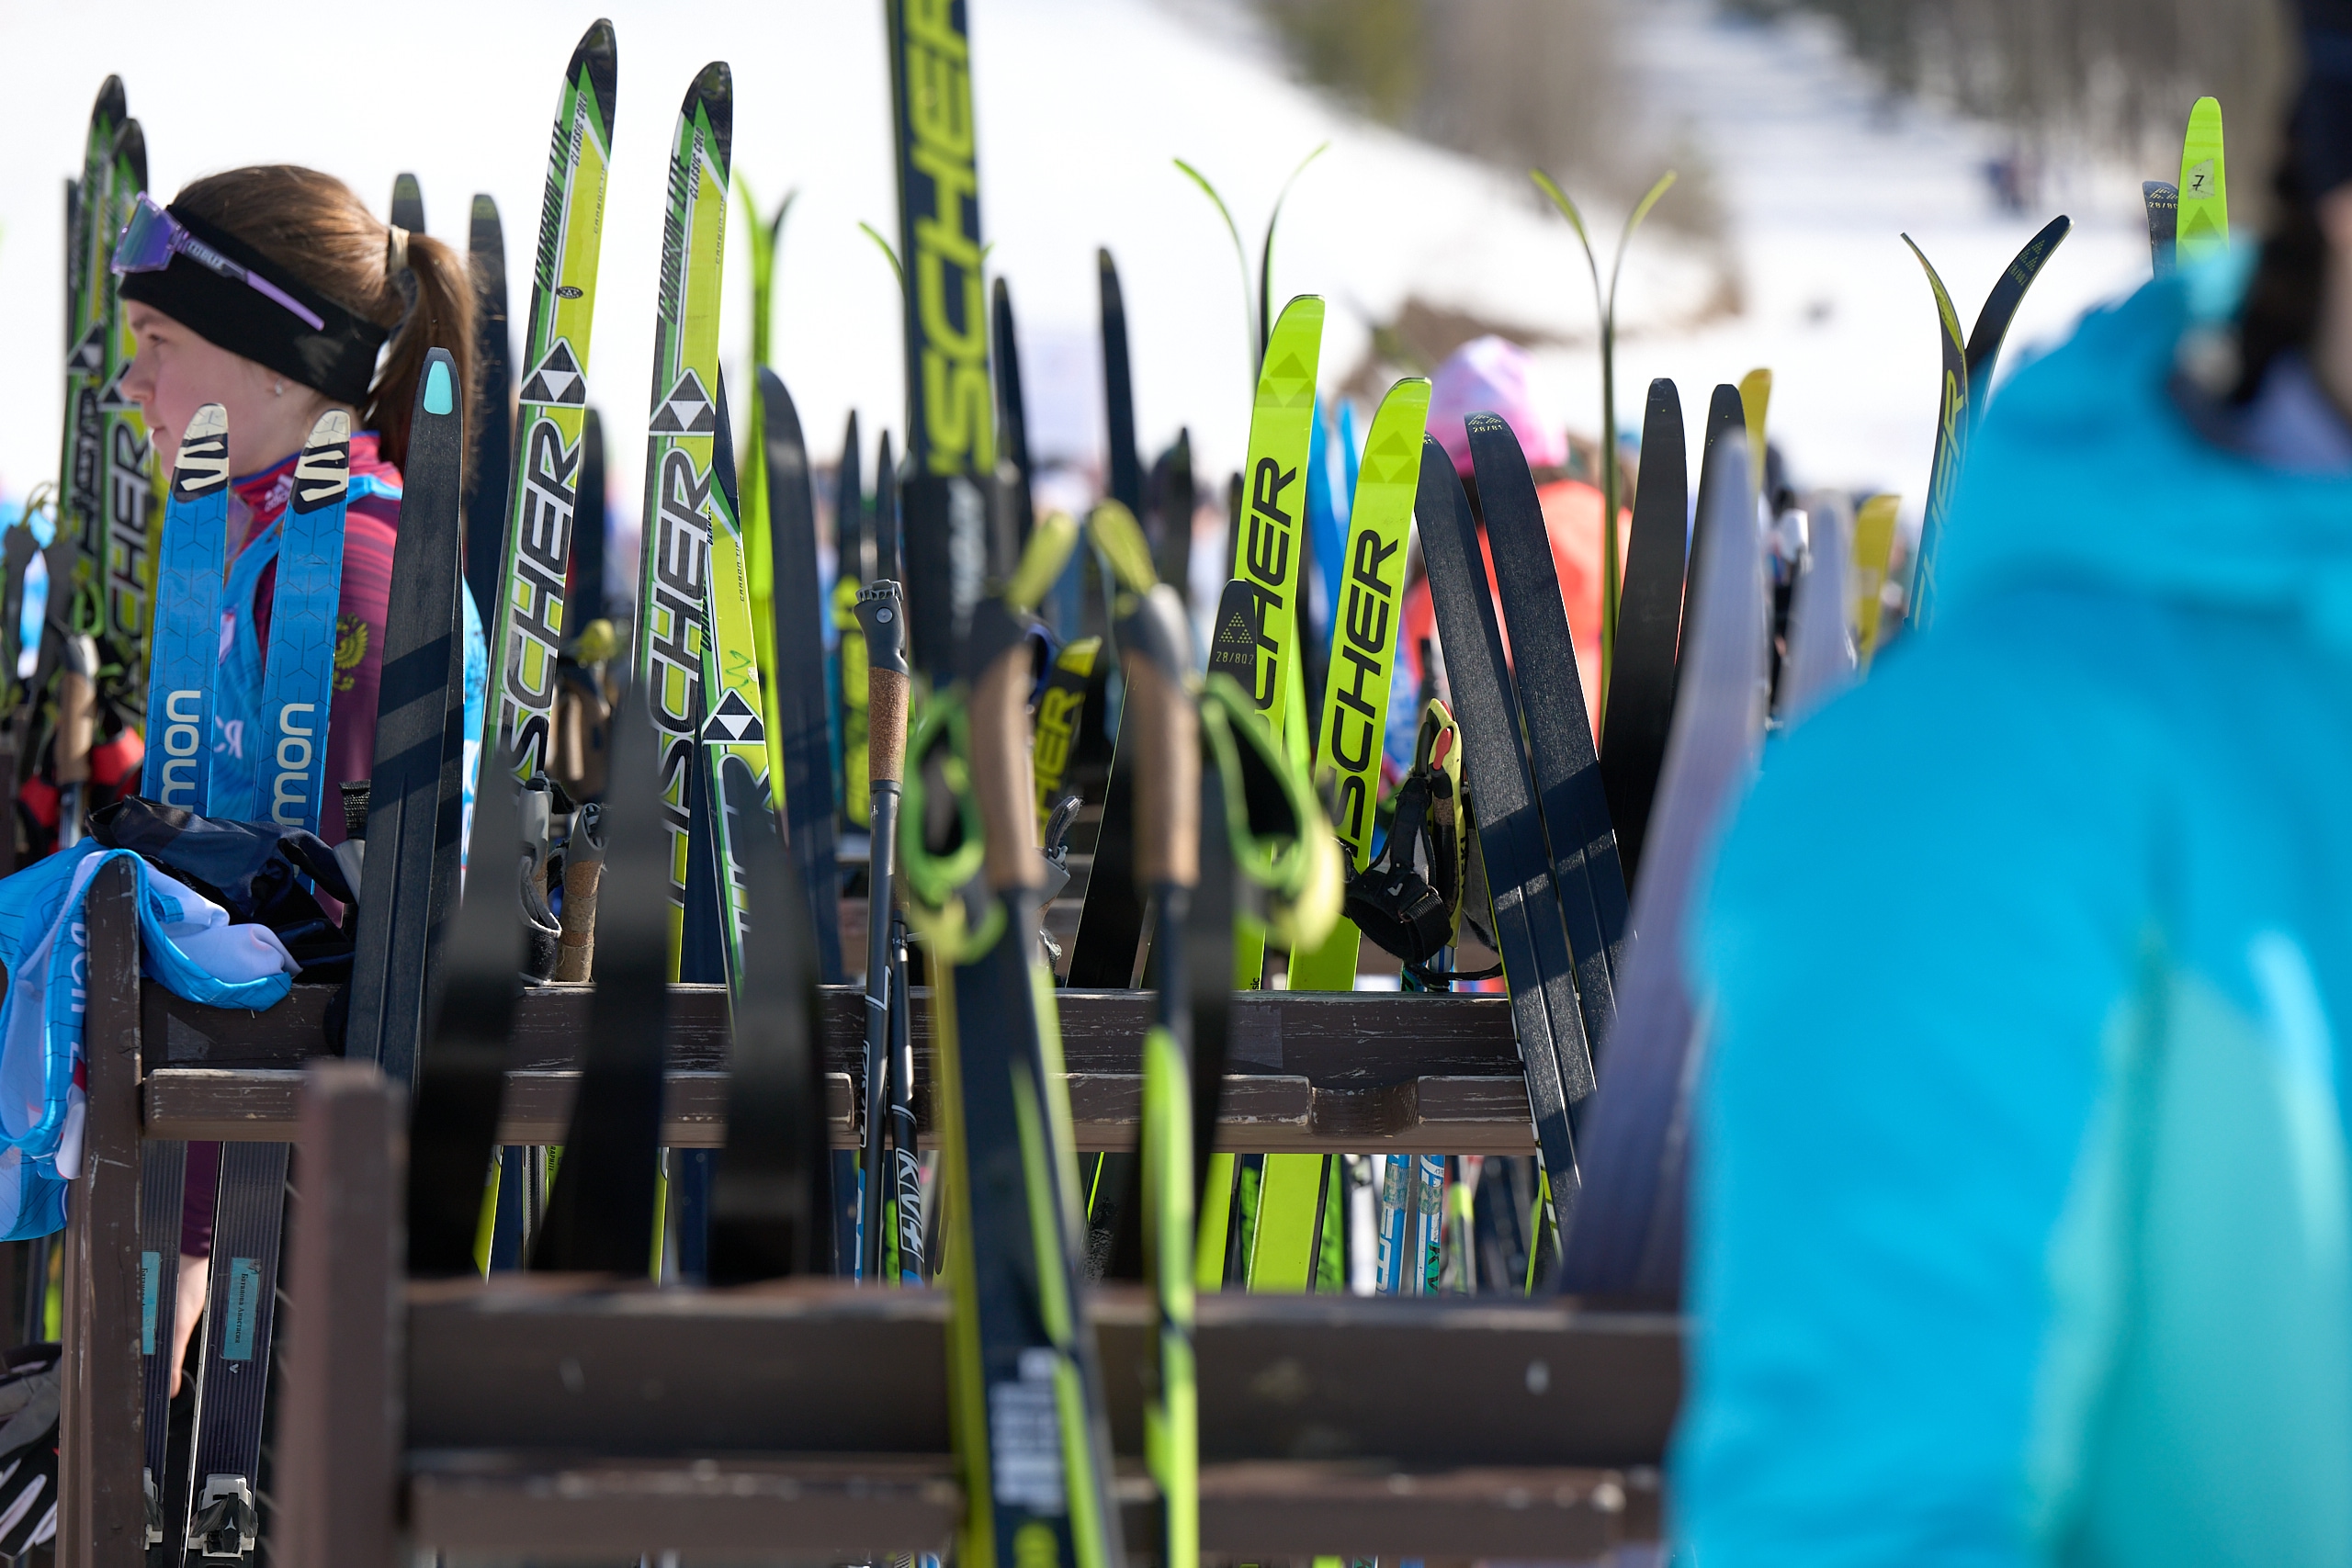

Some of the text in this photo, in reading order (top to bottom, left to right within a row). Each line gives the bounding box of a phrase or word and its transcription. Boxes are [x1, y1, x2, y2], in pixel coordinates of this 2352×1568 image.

[549, 118, 572, 180] LITE
[571, 91, 588, 167] CLASSIC COLD
[667, 150, 689, 212] LITE
[689, 127, 705, 200] CLASSIC COLD
[2192, 175, 2205, 191] 7
[736, 562, 745, 602] CARBON
[161, 690, 201, 812] mon
